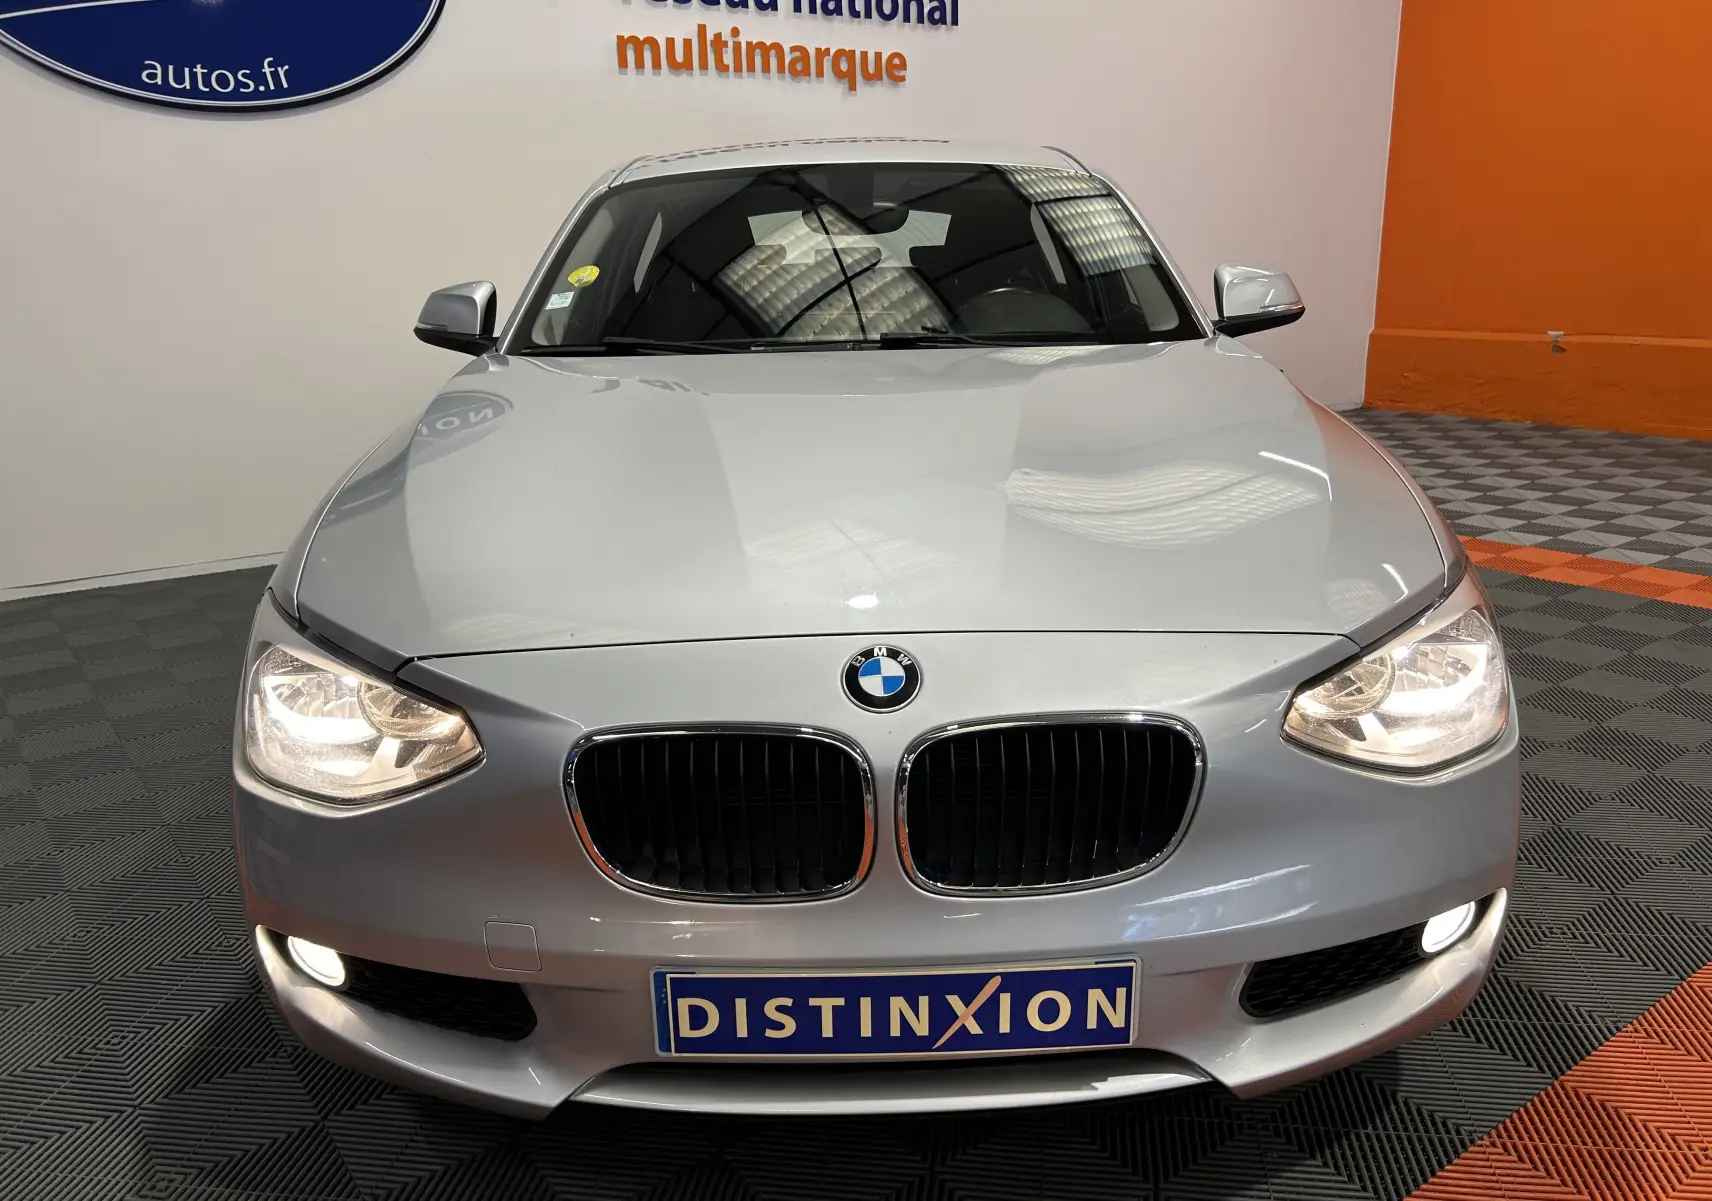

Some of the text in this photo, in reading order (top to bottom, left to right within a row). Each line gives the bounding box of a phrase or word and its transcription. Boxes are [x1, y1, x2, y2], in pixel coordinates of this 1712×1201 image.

[141, 57, 290, 92] autos.fr
[616, 24, 907, 91] multimarque
[851, 646, 912, 667] BMW
[676, 975, 1127, 1049] DISTINXION
